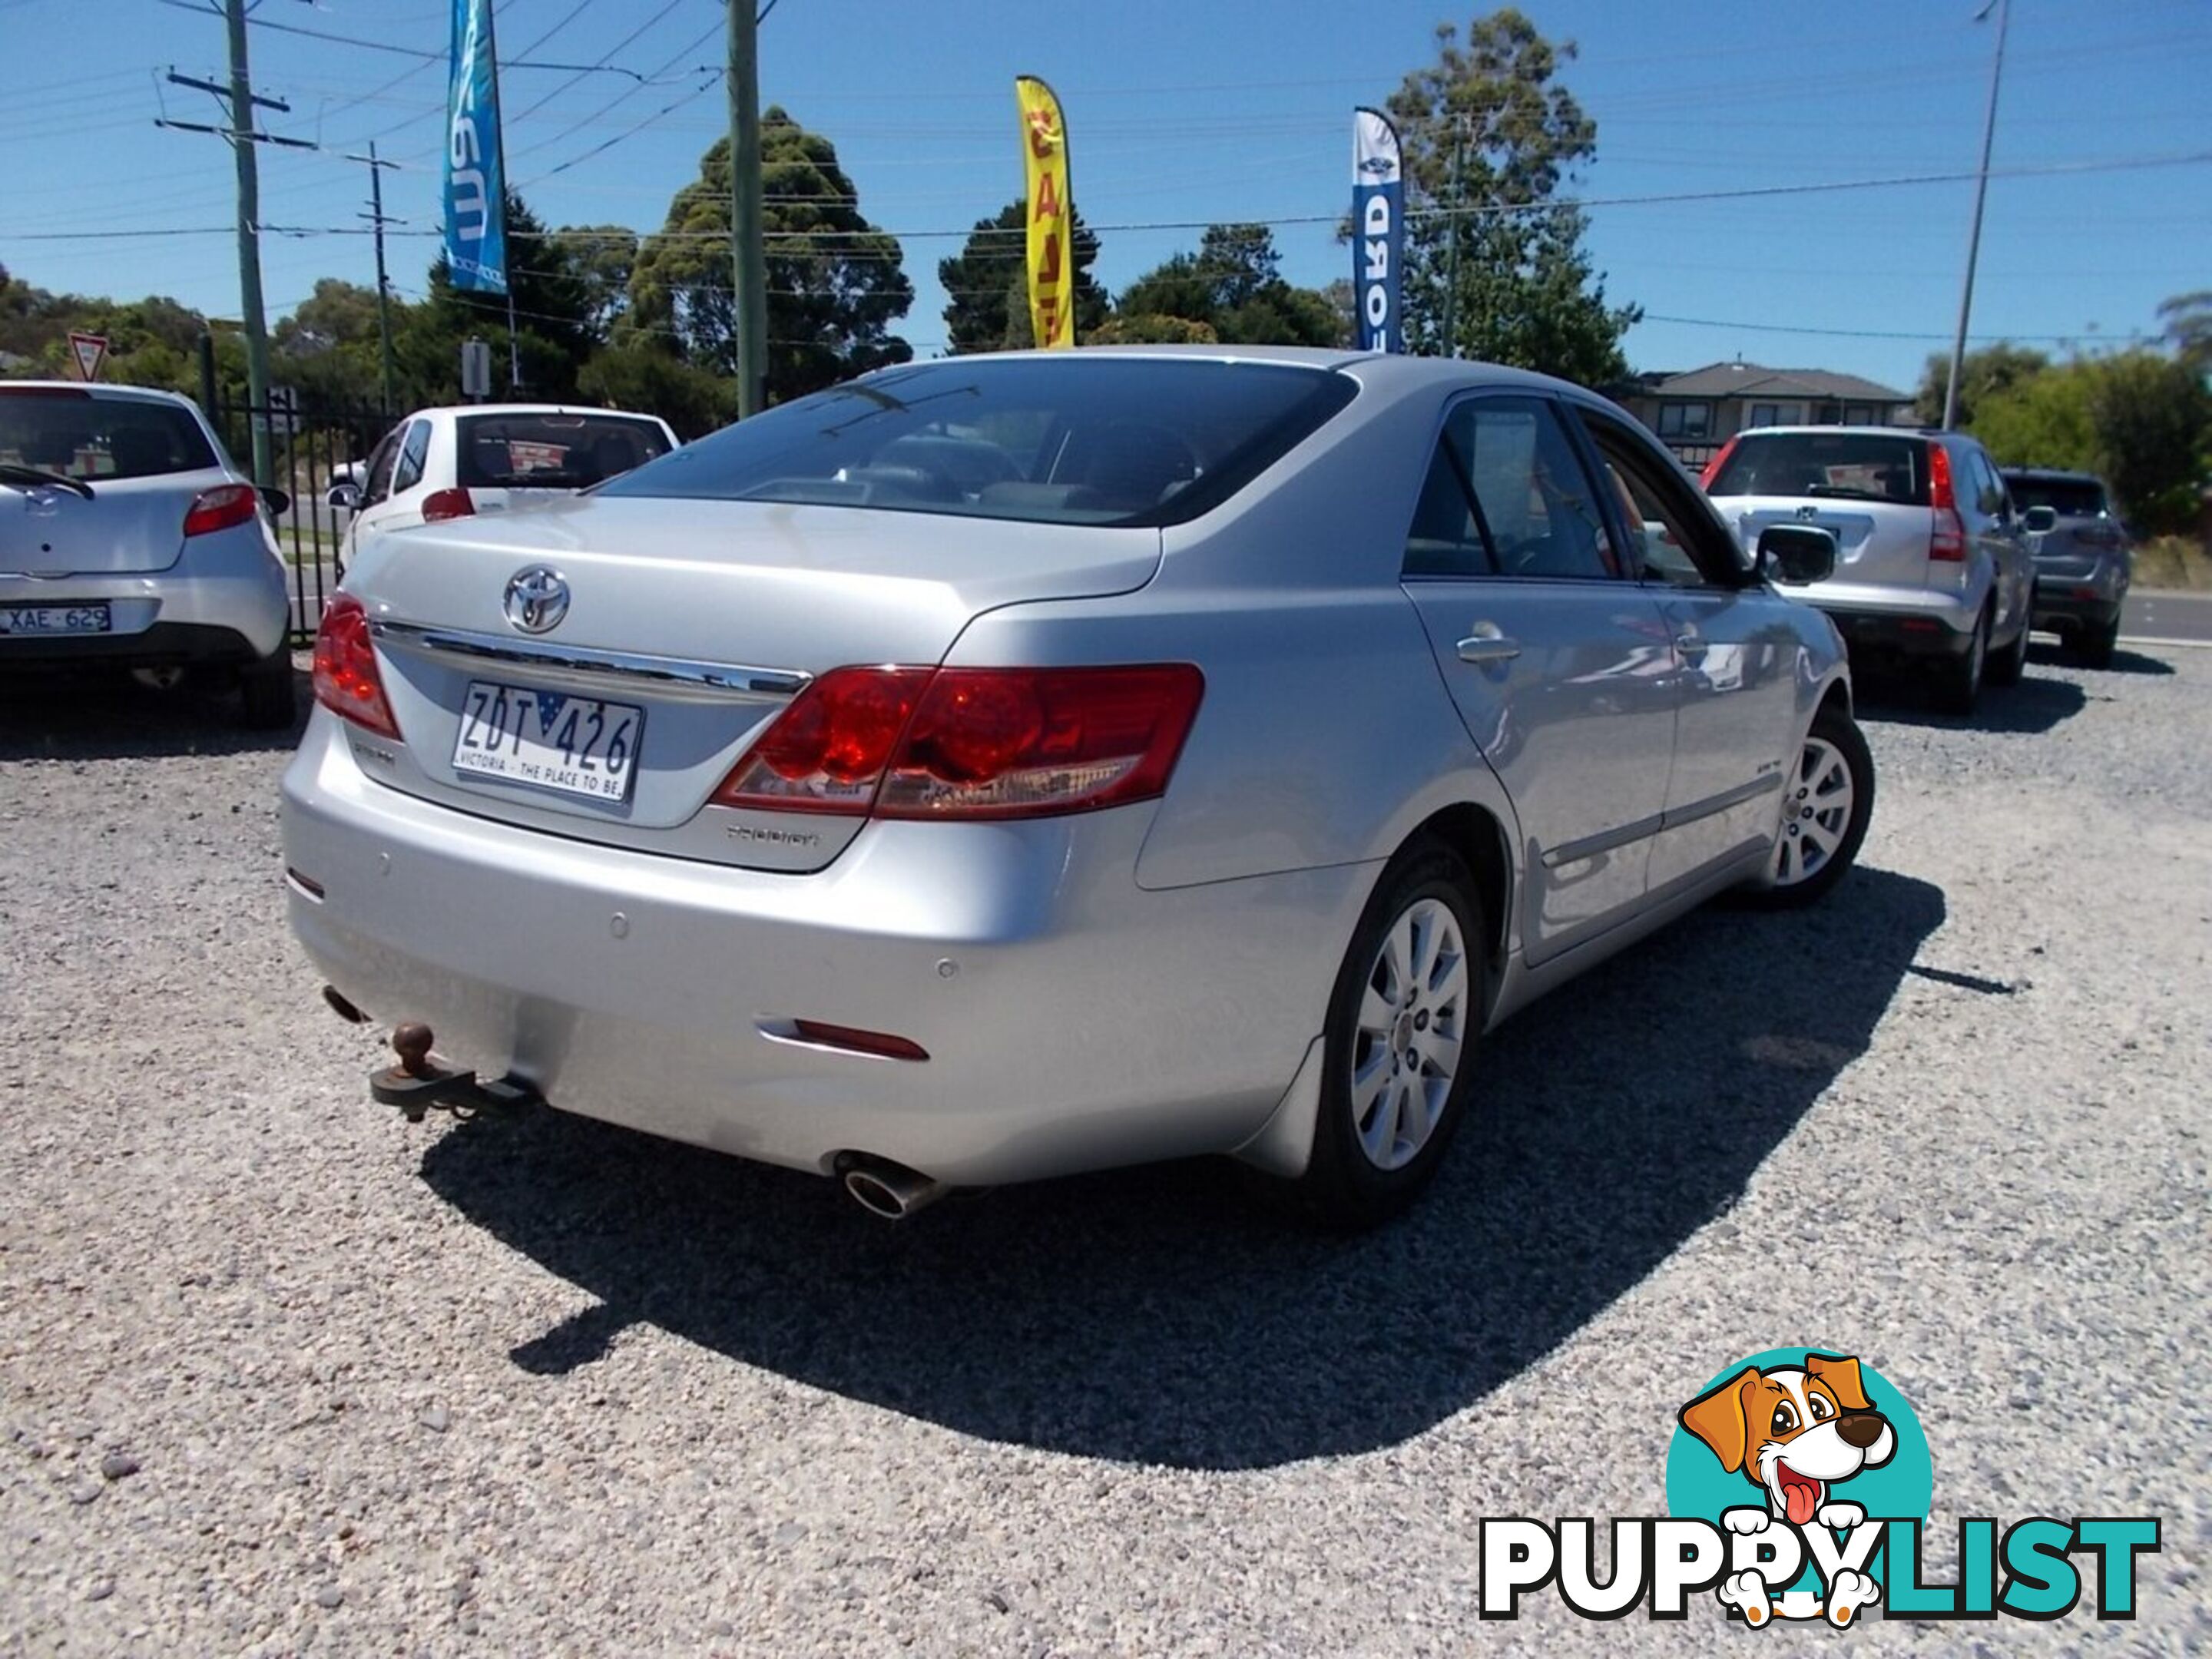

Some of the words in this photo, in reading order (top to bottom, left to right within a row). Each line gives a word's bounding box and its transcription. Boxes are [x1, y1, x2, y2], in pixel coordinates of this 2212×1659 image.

[462, 693, 532, 756] ZDT
[556, 708, 631, 774] 426
[460, 753, 506, 770] VICTORIA
[521, 763, 540, 779] THE
[545, 767, 578, 786] PLACE
[584, 775, 598, 790] TO
[603, 780, 622, 796] BE.
